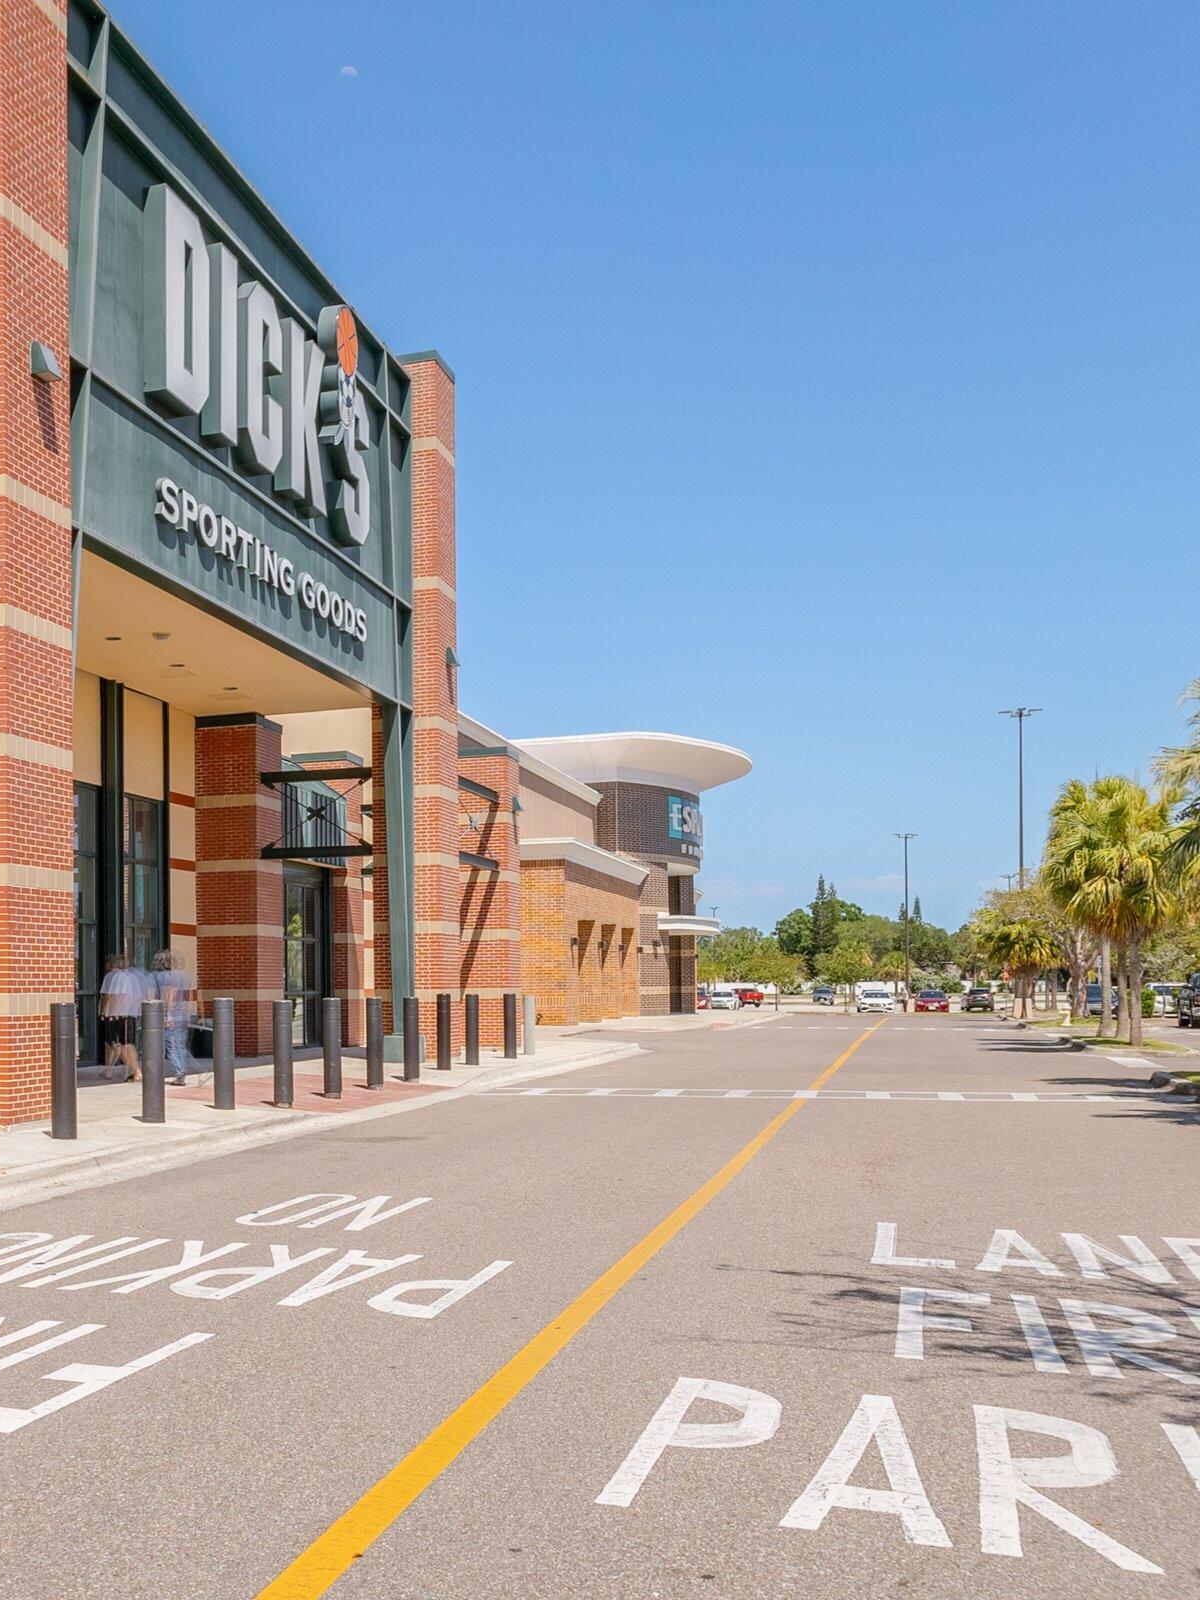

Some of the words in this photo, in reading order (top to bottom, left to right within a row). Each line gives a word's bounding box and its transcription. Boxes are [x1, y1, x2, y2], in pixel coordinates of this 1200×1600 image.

[155, 477, 295, 596] SPORTING
[297, 572, 367, 642] GOODS
[236, 1193, 432, 1230] NO
[894, 1287, 1200, 1385] FIR
